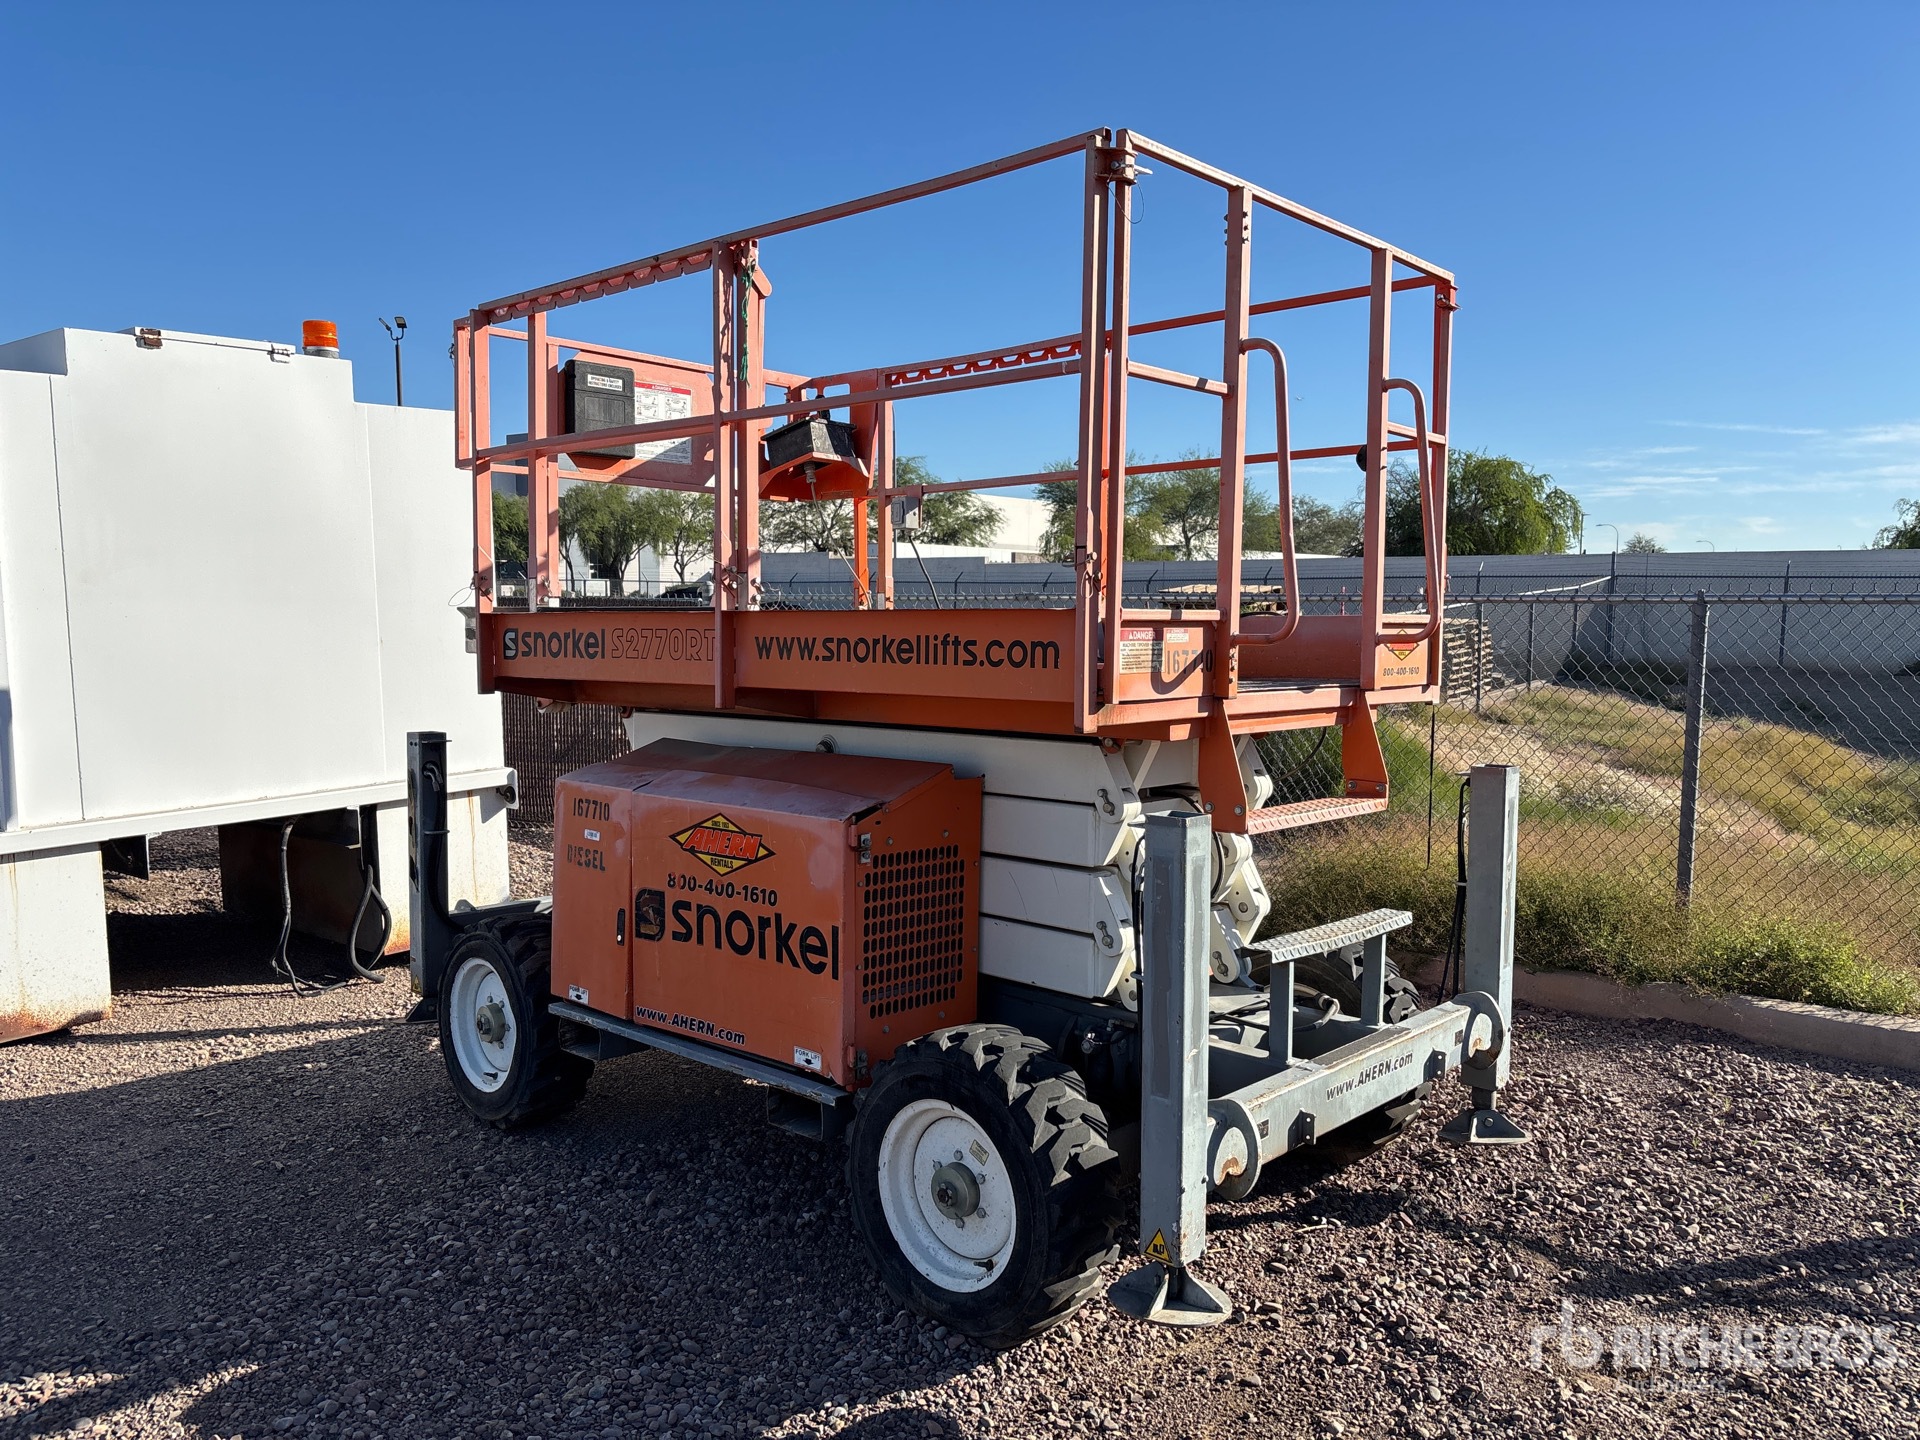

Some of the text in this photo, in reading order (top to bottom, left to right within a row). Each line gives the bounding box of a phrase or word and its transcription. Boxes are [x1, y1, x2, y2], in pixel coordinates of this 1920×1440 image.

[521, 628, 606, 660] snorkel
[611, 627, 716, 662] S2770RT
[1133, 630, 1156, 640] DANGER
[754, 632, 1060, 670] www.snorkellifts.com
[1382, 666, 1420, 677] 800-400-1610
[573, 797, 610, 821] 167710
[567, 843, 606, 872] DIESEL
[682, 827, 761, 860] AHERN
[710, 857, 734, 869] RENTALS
[671, 899, 840, 981] snorkel
[636, 1005, 746, 1045] www.AHERN.com
[795, 1048, 821, 1062] FORK LIFT
[1326, 1052, 1413, 1101] www.AHERN.com
